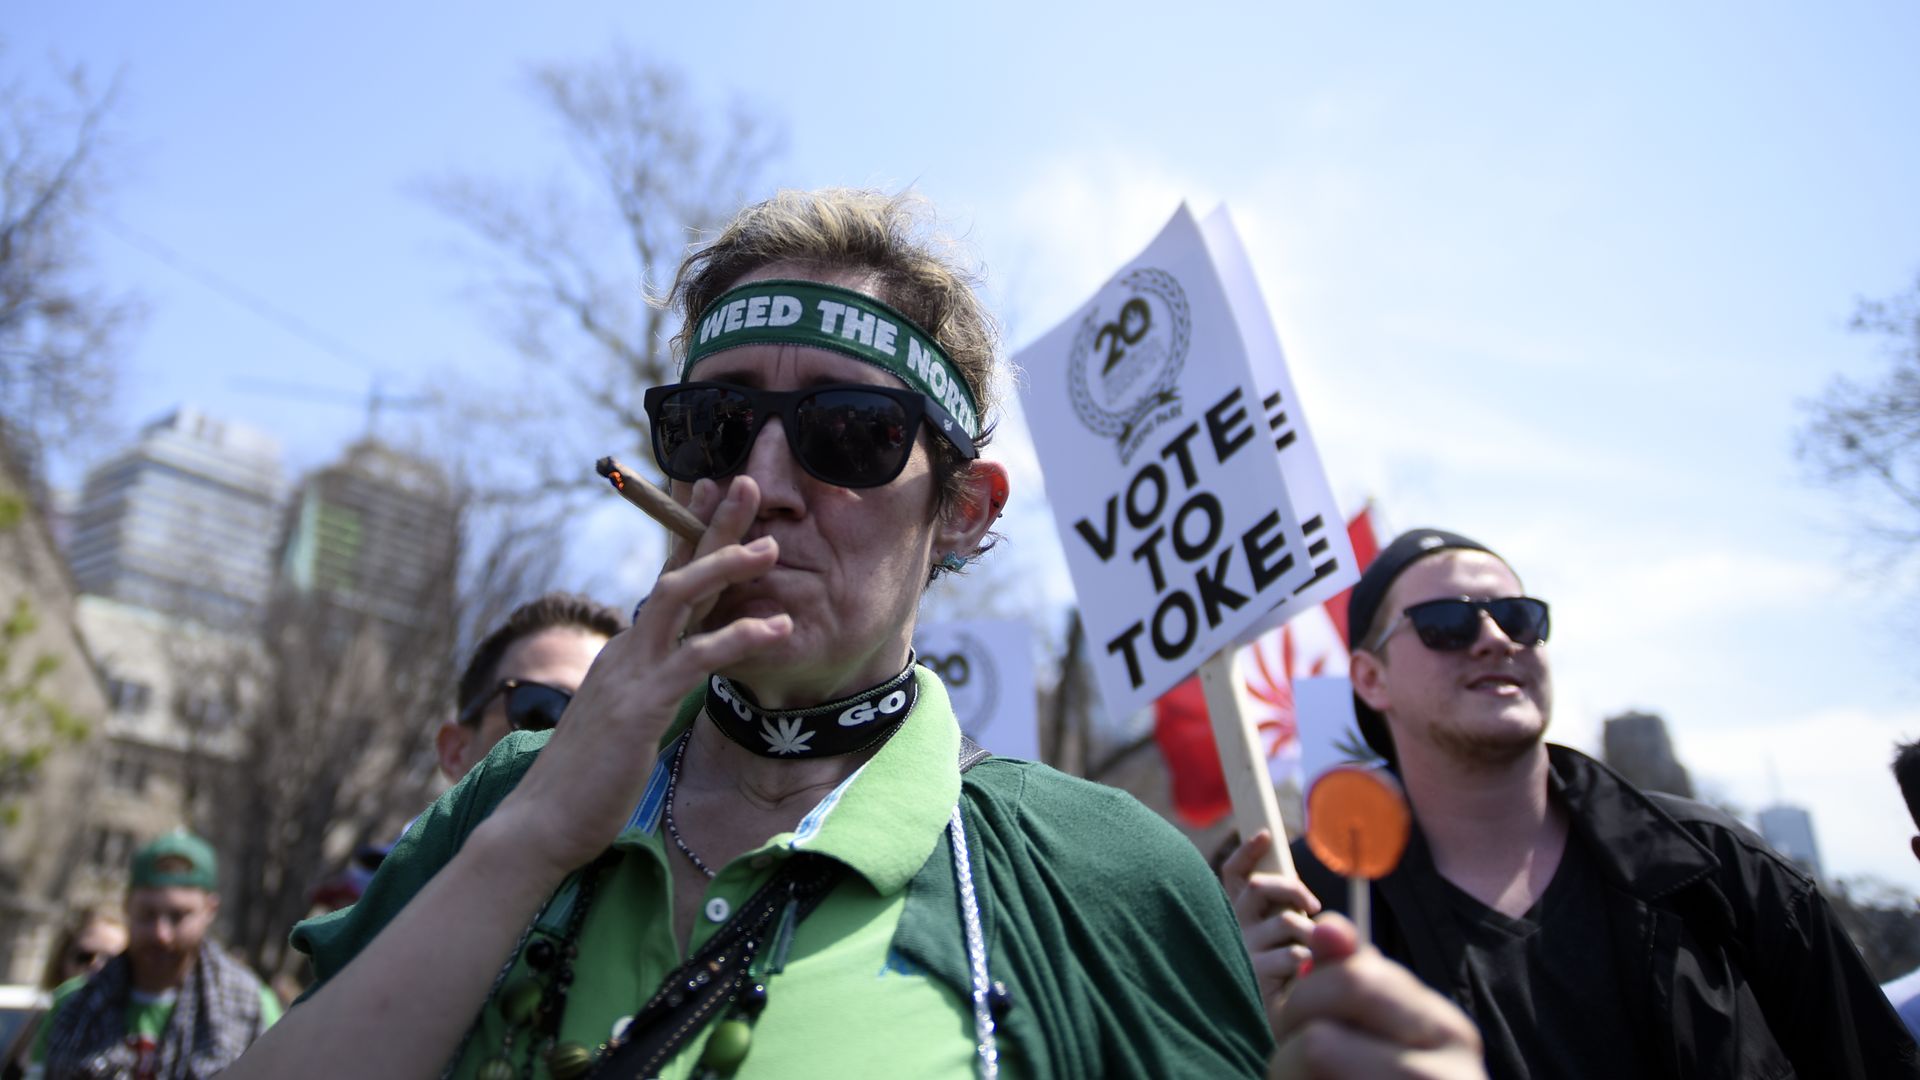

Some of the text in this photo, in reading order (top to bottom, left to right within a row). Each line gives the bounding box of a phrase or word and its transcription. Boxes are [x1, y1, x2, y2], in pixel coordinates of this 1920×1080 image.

[700, 295, 802, 344] WEED
[818, 300, 897, 356] THE
[1094, 298, 1152, 377] 20
[1074, 387, 1256, 563] VOTE
[1132, 492, 1225, 594] TO
[1107, 509, 1295, 690] TOKE
[711, 674, 906, 727] GO GO
